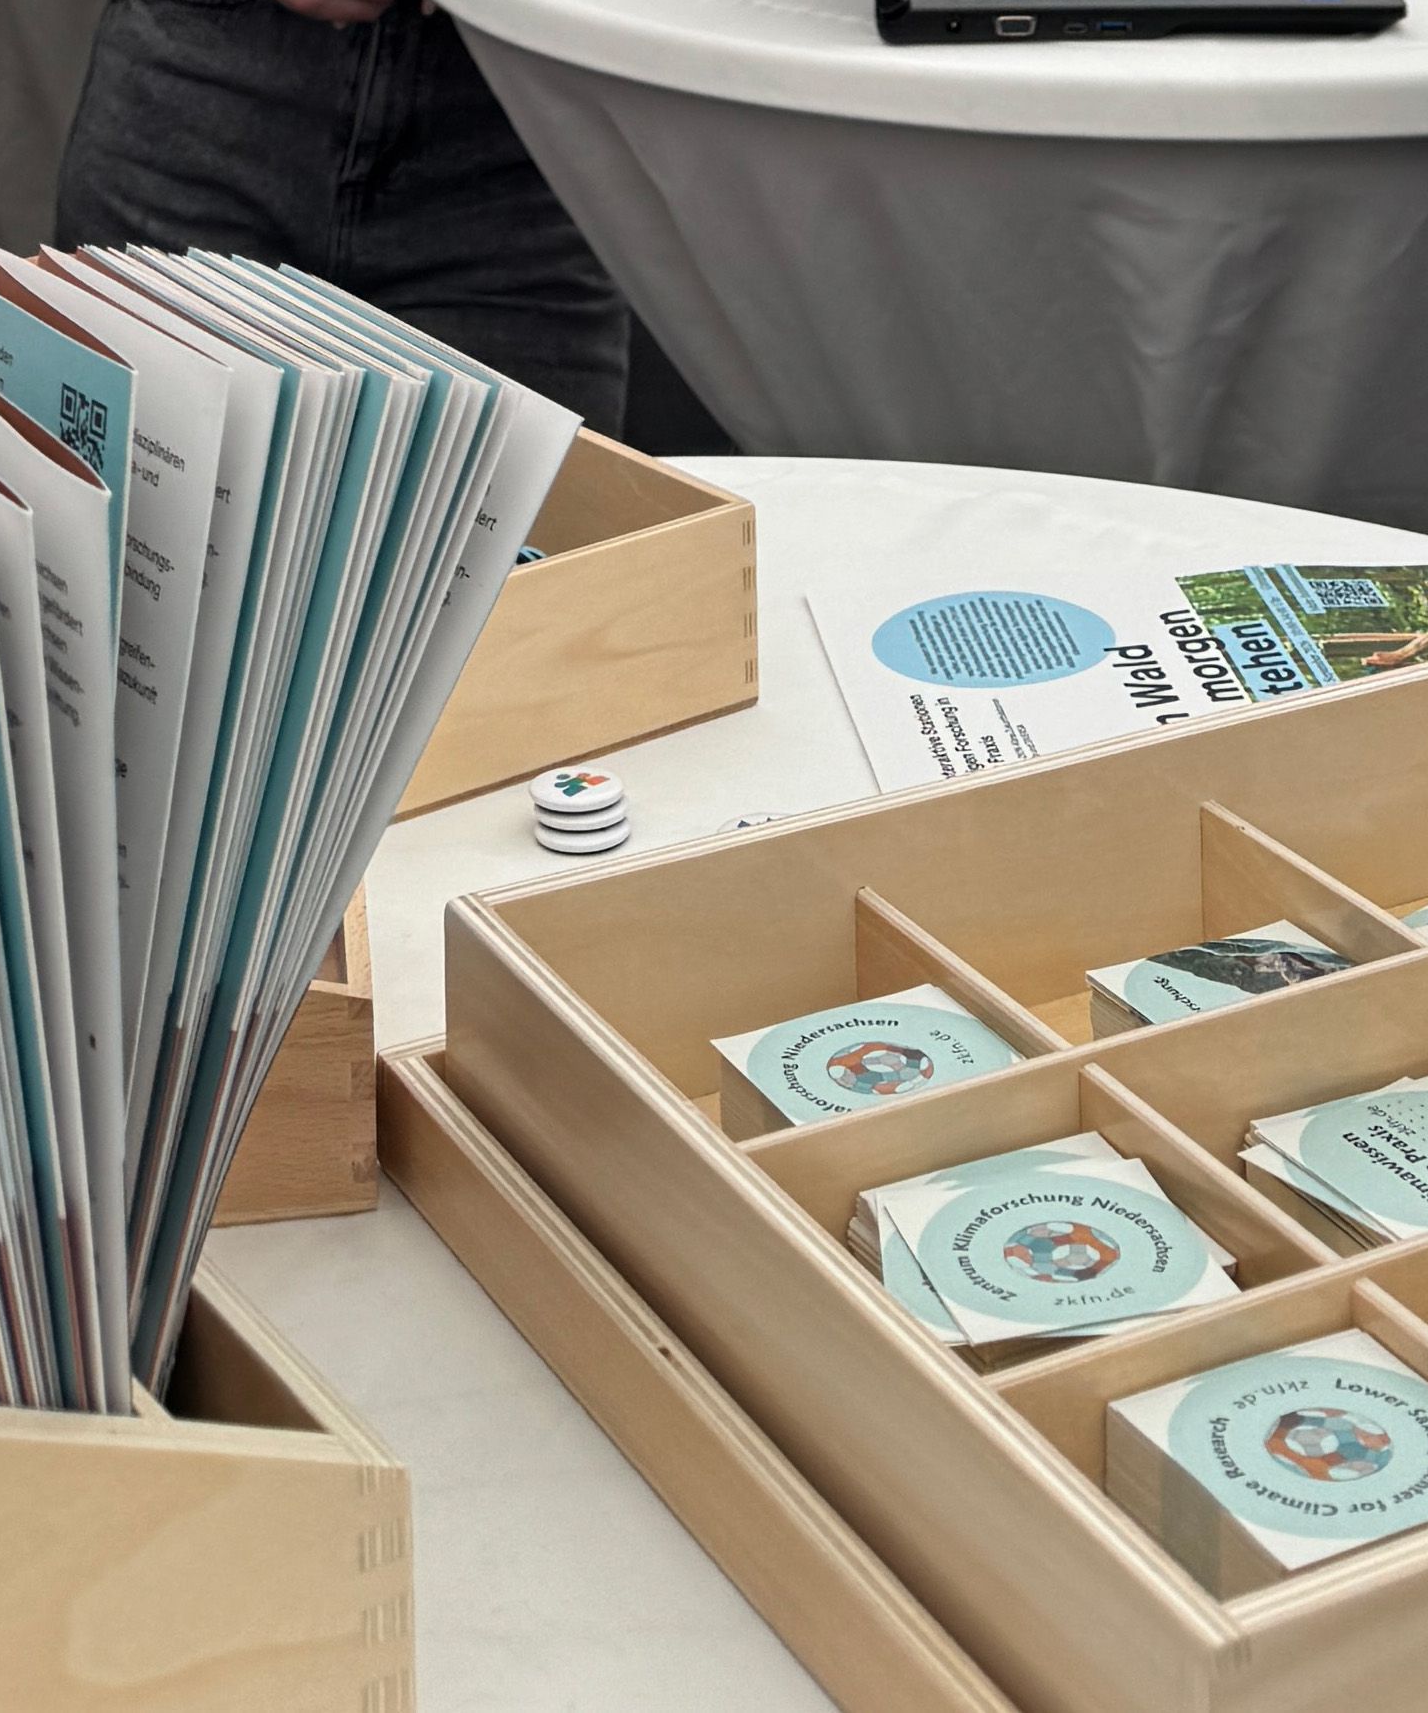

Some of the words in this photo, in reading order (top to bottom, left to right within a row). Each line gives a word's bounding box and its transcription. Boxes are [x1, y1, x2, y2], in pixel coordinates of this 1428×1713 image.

[1104, 644, 1180, 709] Wald
[1158, 609, 1245, 703] morgen
[910, 694, 938, 736] Stationen
[940, 706, 973, 753] Forschung
[978, 735, 1005, 764] Praxis
[781, 1017, 900, 1060] Niedersachsen
[929, 1028, 975, 1066] zkfn.de
[1368, 1124, 1428, 1164] Praxis
[953, 1192, 1084, 1252] Klimaforschung
[1090, 1195, 1174, 1275] Niedersachsen
[958, 1255, 1018, 1303] Zentrum
[1054, 1284, 1137, 1307] zkfn.de
[1233, 1378, 1309, 1411] zkfn.de
[1335, 1377, 1410, 1409] Lower
[1209, 1416, 1247, 1481] Research
[1245, 1479, 1339, 1518] Climate
[1347, 1498, 1388, 1515] for
